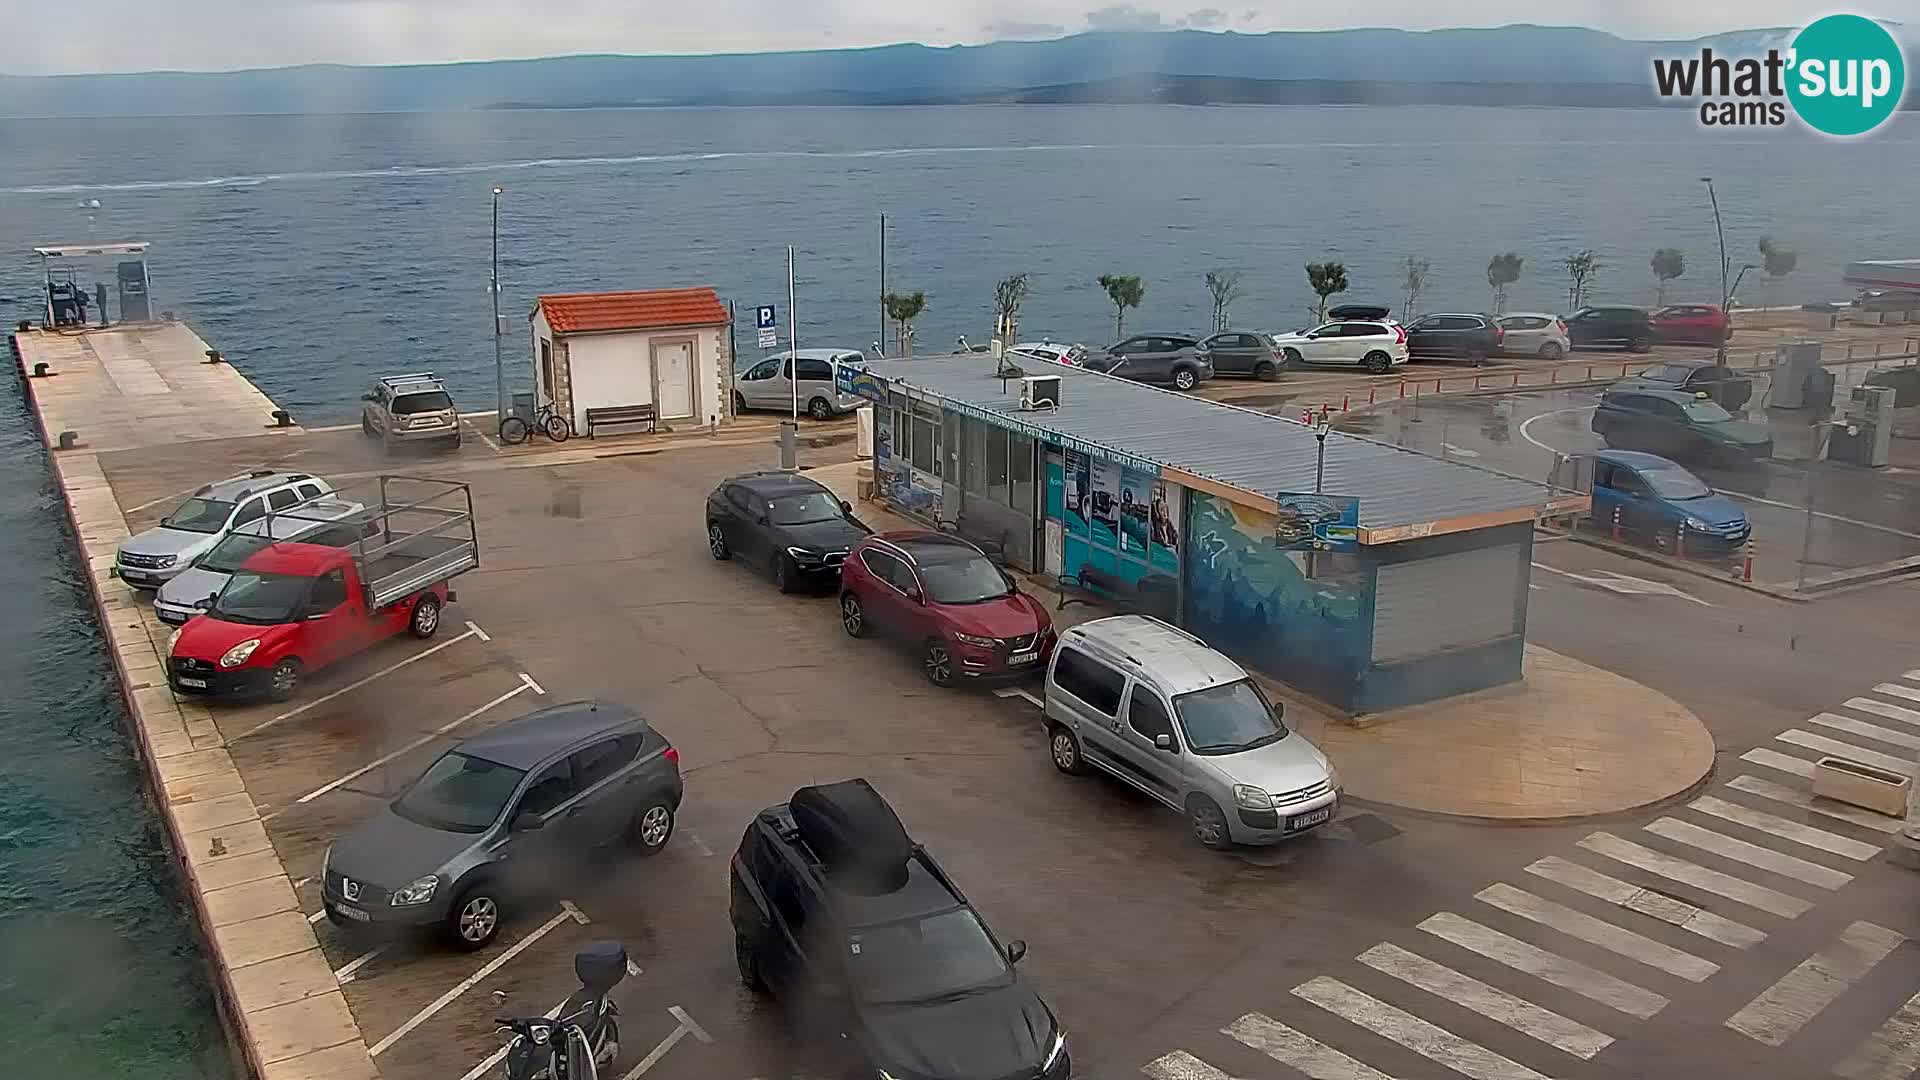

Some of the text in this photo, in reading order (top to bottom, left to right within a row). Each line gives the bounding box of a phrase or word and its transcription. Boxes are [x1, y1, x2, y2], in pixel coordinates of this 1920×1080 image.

[760, 308, 771, 325] P
[1022, 425, 1051, 441] POSTAJA
[1060, 437, 1073, 449] BUS
[1075, 440, 1105, 458] STATION
[1106, 450, 1131, 467] TICKET
[1132, 458, 1157, 474] OFFICE
